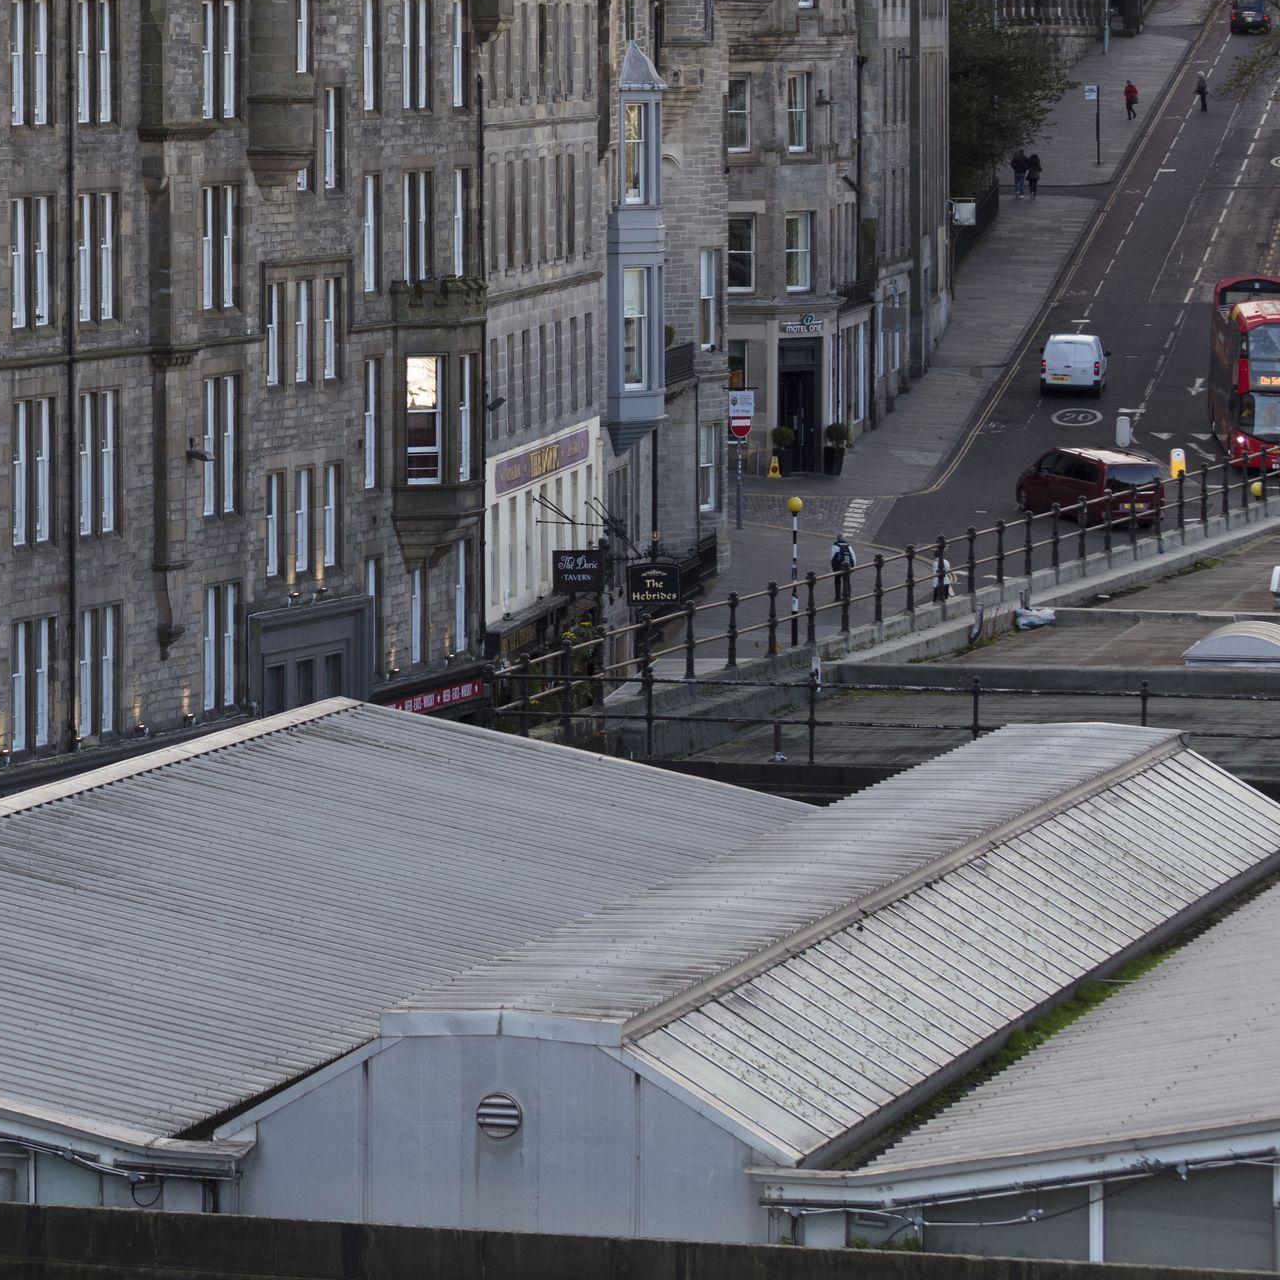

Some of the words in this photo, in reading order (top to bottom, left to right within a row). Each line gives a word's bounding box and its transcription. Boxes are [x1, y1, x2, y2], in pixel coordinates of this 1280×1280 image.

[557, 555, 575, 569] The
[575, 554, 599, 569] Doric
[645, 579, 664, 588] The
[632, 591, 677, 600] Hebrides
